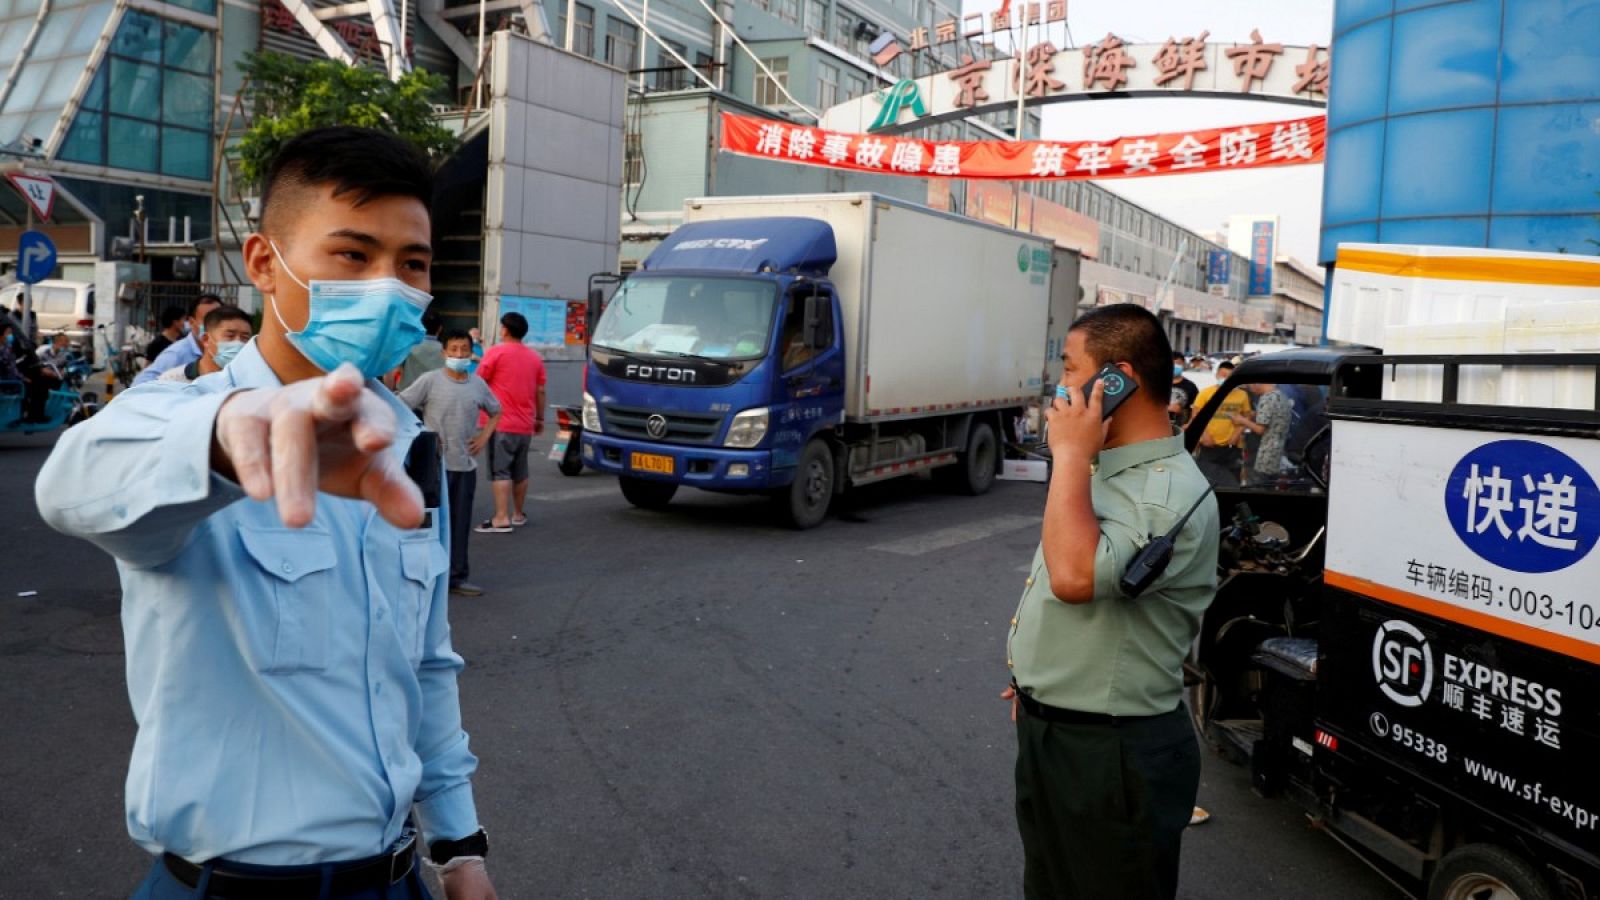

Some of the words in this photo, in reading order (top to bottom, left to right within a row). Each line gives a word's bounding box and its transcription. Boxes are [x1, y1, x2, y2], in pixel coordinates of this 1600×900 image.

[756, 122, 961, 175] 消除事故隐患
[1031, 122, 1313, 177] 筑牢安全防线
[626, 364, 697, 382] FOTON
[1463, 463, 1578, 551] 快递
[1383, 640, 1422, 685] SF
[1444, 653, 1562, 716] EXPRESS
[1442, 681, 1561, 750] 顺丰速运
[1392, 723, 1448, 763] 95338
[1464, 757, 1600, 830] www.sf-expr
